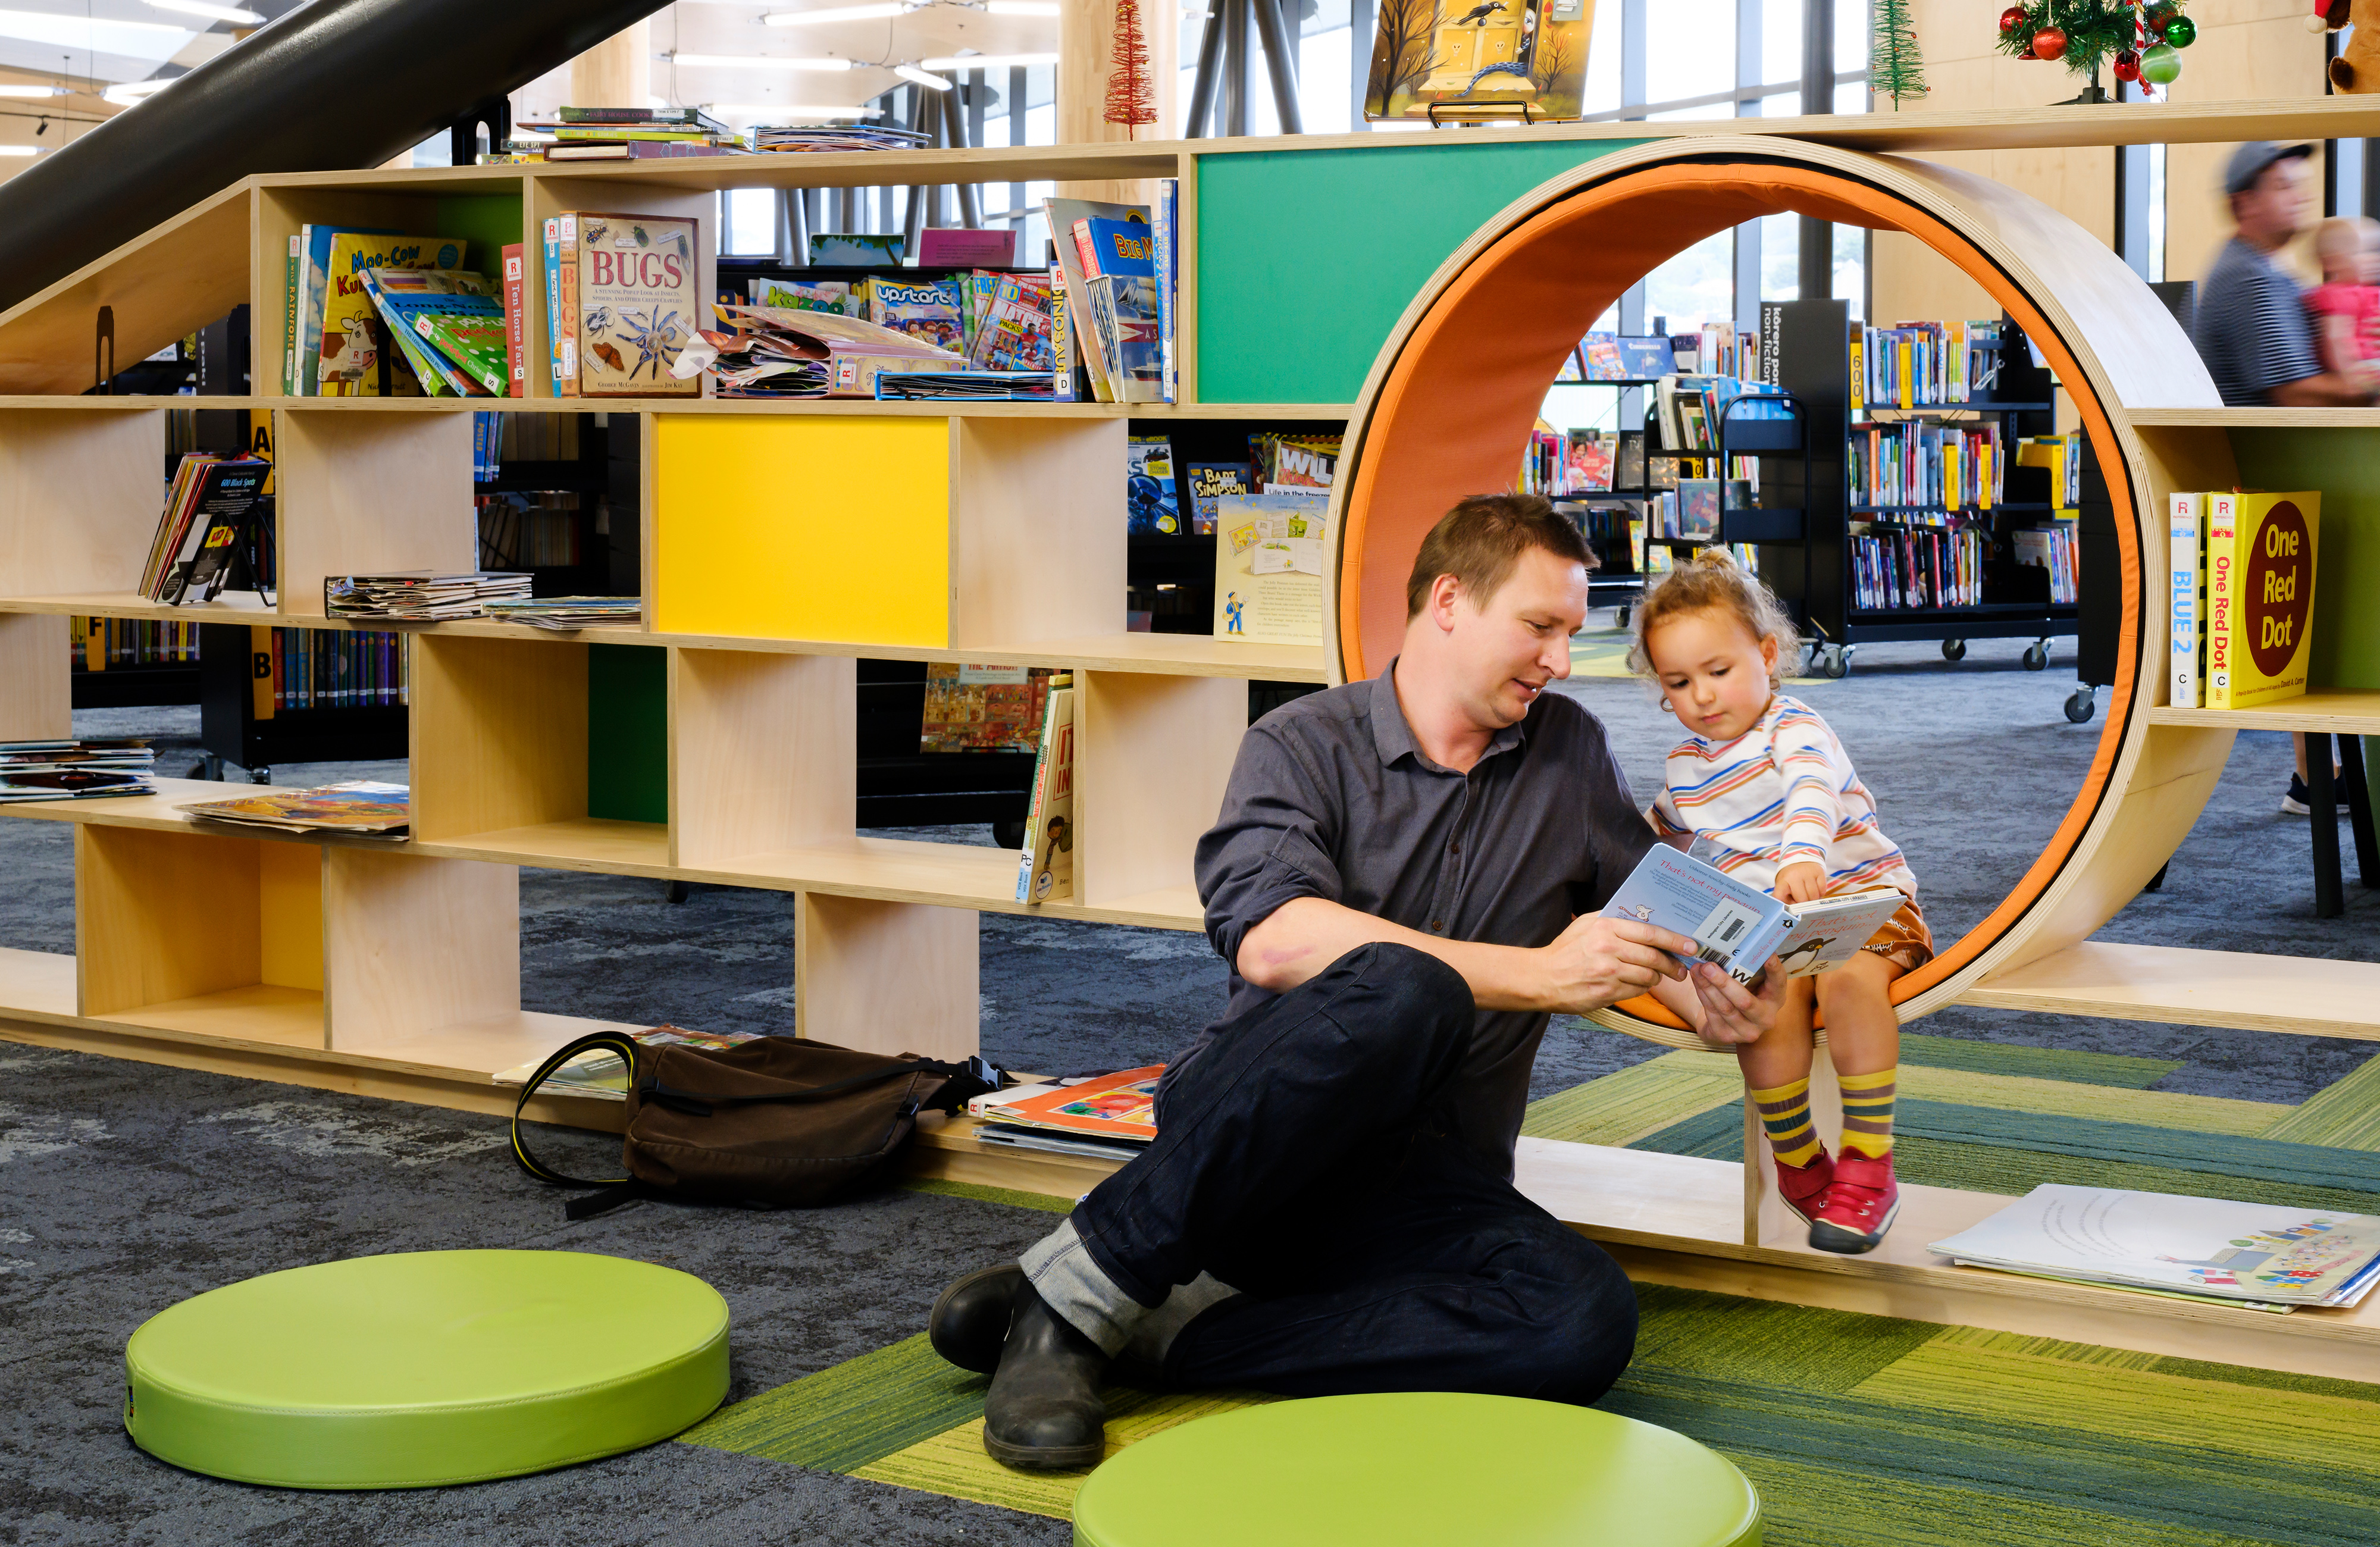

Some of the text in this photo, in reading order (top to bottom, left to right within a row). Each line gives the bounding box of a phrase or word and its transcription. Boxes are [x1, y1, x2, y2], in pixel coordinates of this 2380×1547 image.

[549, 225, 555, 236] R
[565, 221, 572, 233] R
[292, 239, 298, 250] R
[1113, 233, 1144, 261] BIG
[511, 262, 517, 273] R
[590, 250, 682, 289] BUGS
[1056, 270, 1063, 282] R
[512, 284, 520, 302] Ten
[768, 286, 845, 316] kazoo
[878, 286, 950, 303] upstart
[1001, 284, 1019, 301] 10
[561, 268, 575, 339] BUGS
[288, 286, 296, 347] RAINFORE
[991, 299, 1041, 333] MATCH
[991, 315, 998, 324] 2
[419, 321, 428, 331] R
[999, 320, 1023, 334] PACKS!
[404, 329, 413, 339] THE
[411, 336, 436, 365] LONG-NOSED
[1764, 308, 1773, 385] non-fiction
[468, 360, 486, 378] Christm
[843, 369, 851, 378] R
[1165, 368, 1170, 383] E
[1853, 355, 1861, 397] 600
[1061, 380, 1067, 389] D
[252, 427, 272, 453] A
[477, 422, 485, 452] POSTED
[243, 478, 256, 487] Spots
[2178, 502, 2188, 513] R
[2219, 502, 2229, 513] R
[2265, 523, 2299, 559] One
[2263, 565, 2297, 605] Red
[2172, 571, 2192, 654] BLUE 2
[2213, 556, 2230, 670] One Red Dot
[89, 616, 102, 637] F
[2261, 613, 2293, 650] Dot
[254, 652, 271, 678] B
[2178, 674, 2187, 684] C
[2218, 676, 2226, 686] C
[2281, 679, 2290, 688] David
[1057, 766, 1071, 794] IN
[1021, 854, 1027, 862] P
[1025, 857, 1032, 866] C
[1660, 859, 1722, 897] That's not my
[1689, 865, 1751, 898] Usborne touchy-feely books
[1707, 925, 1720, 939] Wellington
[1723, 910, 1733, 922] Libraries
[1807, 915, 1848, 929] That's
[1850, 910, 1877, 921] not
[1774, 927, 1786, 938] That's
[1787, 922, 1875, 942] my penguin...
[1732, 968, 1752, 983] W
[970, 1104, 977, 1113] R
